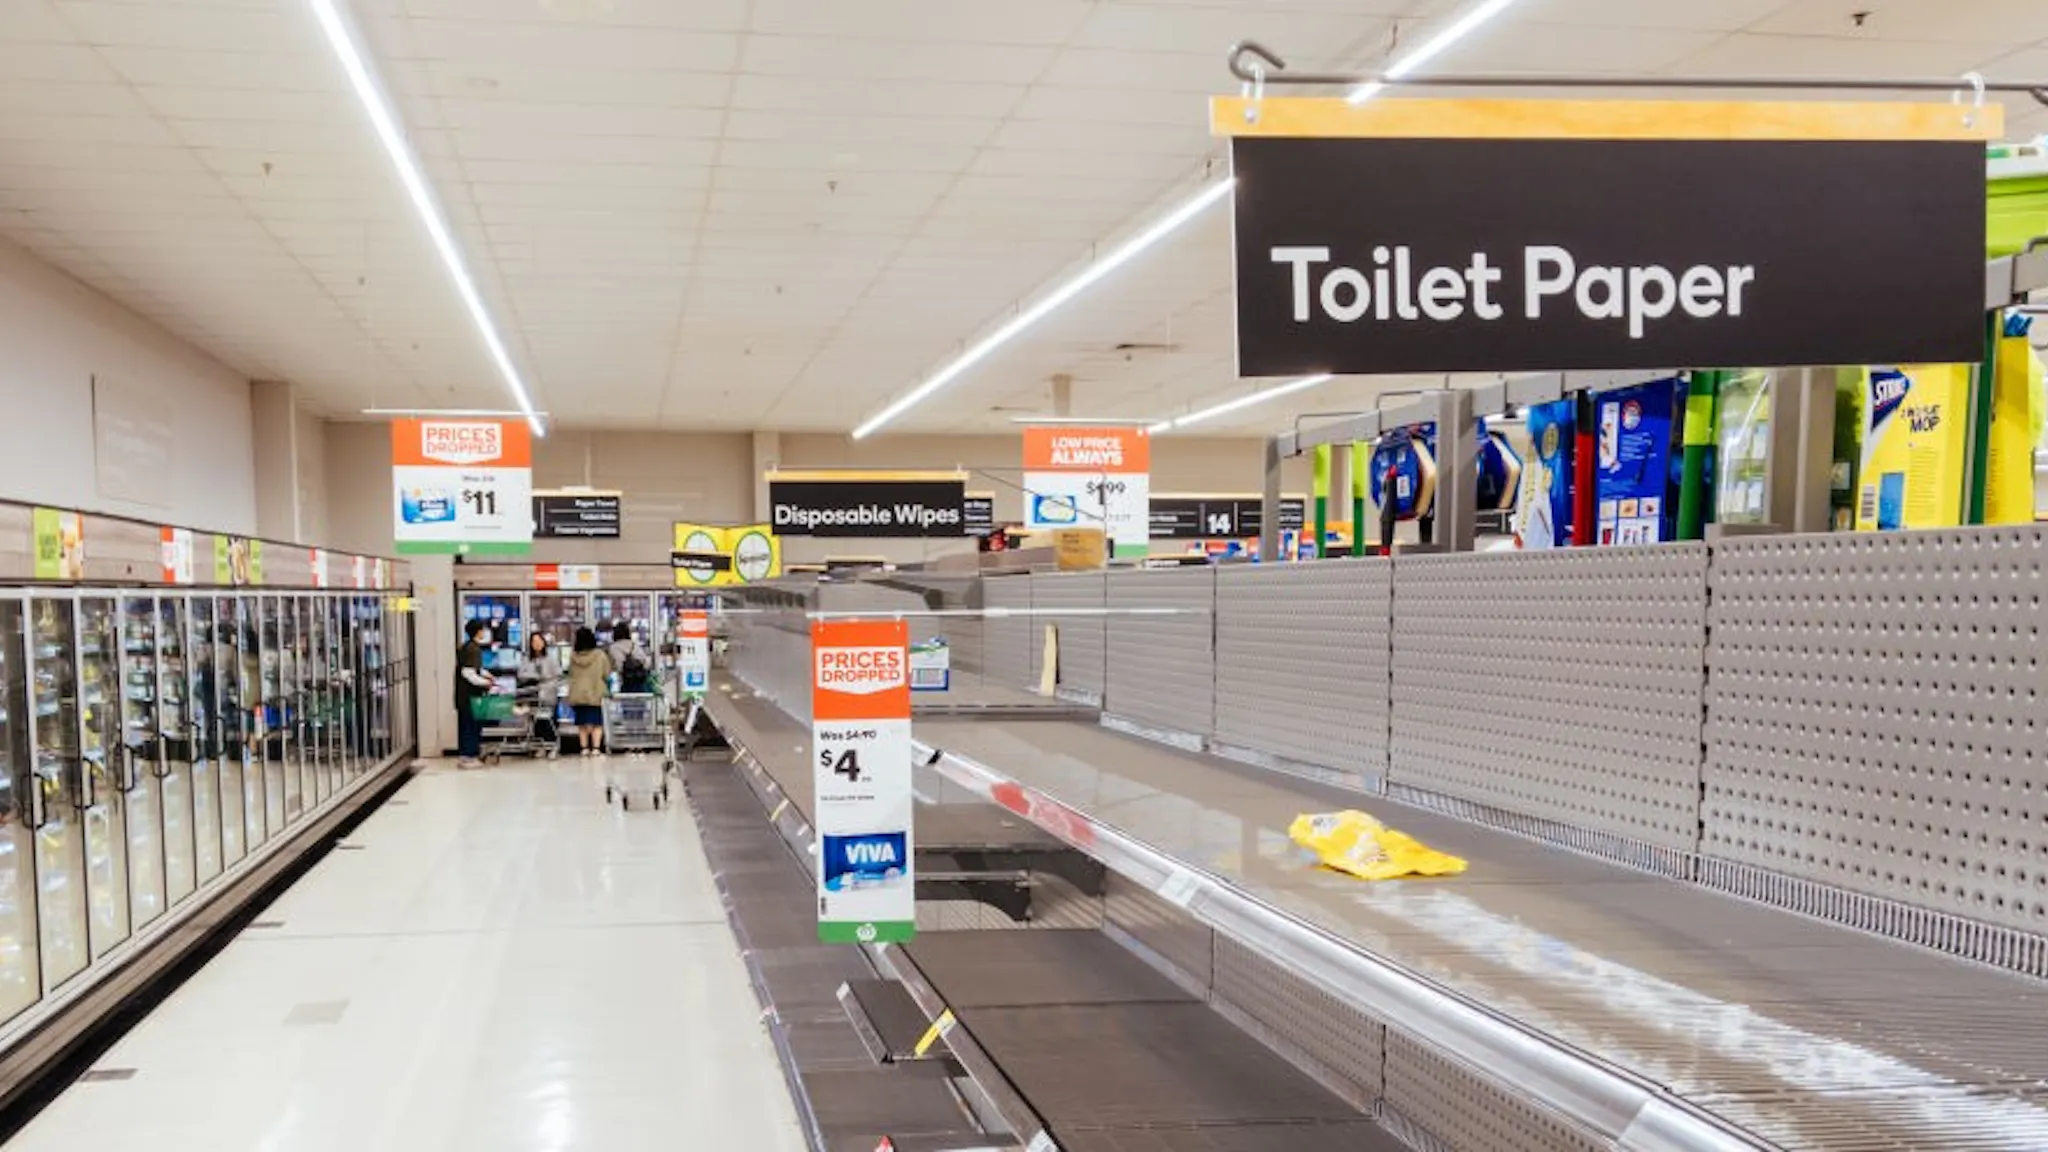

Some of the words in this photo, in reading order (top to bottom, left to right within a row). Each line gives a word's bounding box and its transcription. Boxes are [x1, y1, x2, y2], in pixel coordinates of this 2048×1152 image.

[1271, 246, 1503, 322] Toilet
[1525, 246, 1755, 338] Paper
[426, 427, 497, 441] PRICES
[1052, 437, 1082, 447] LOW
[426, 443, 497, 455] DROPPED
[1051, 450, 1123, 466] ALWAYS
[461, 489, 496, 515] $11
[775, 504, 891, 529] Disposable
[894, 504, 960, 528] Wipes
[1207, 513, 1231, 534] 14
[822, 652, 899, 668] PRICES
[822, 670, 900, 682] DROPPED
[820, 731, 844, 740] Was
[820, 748, 861, 782] $4
[845, 842, 896, 865] VIVA
